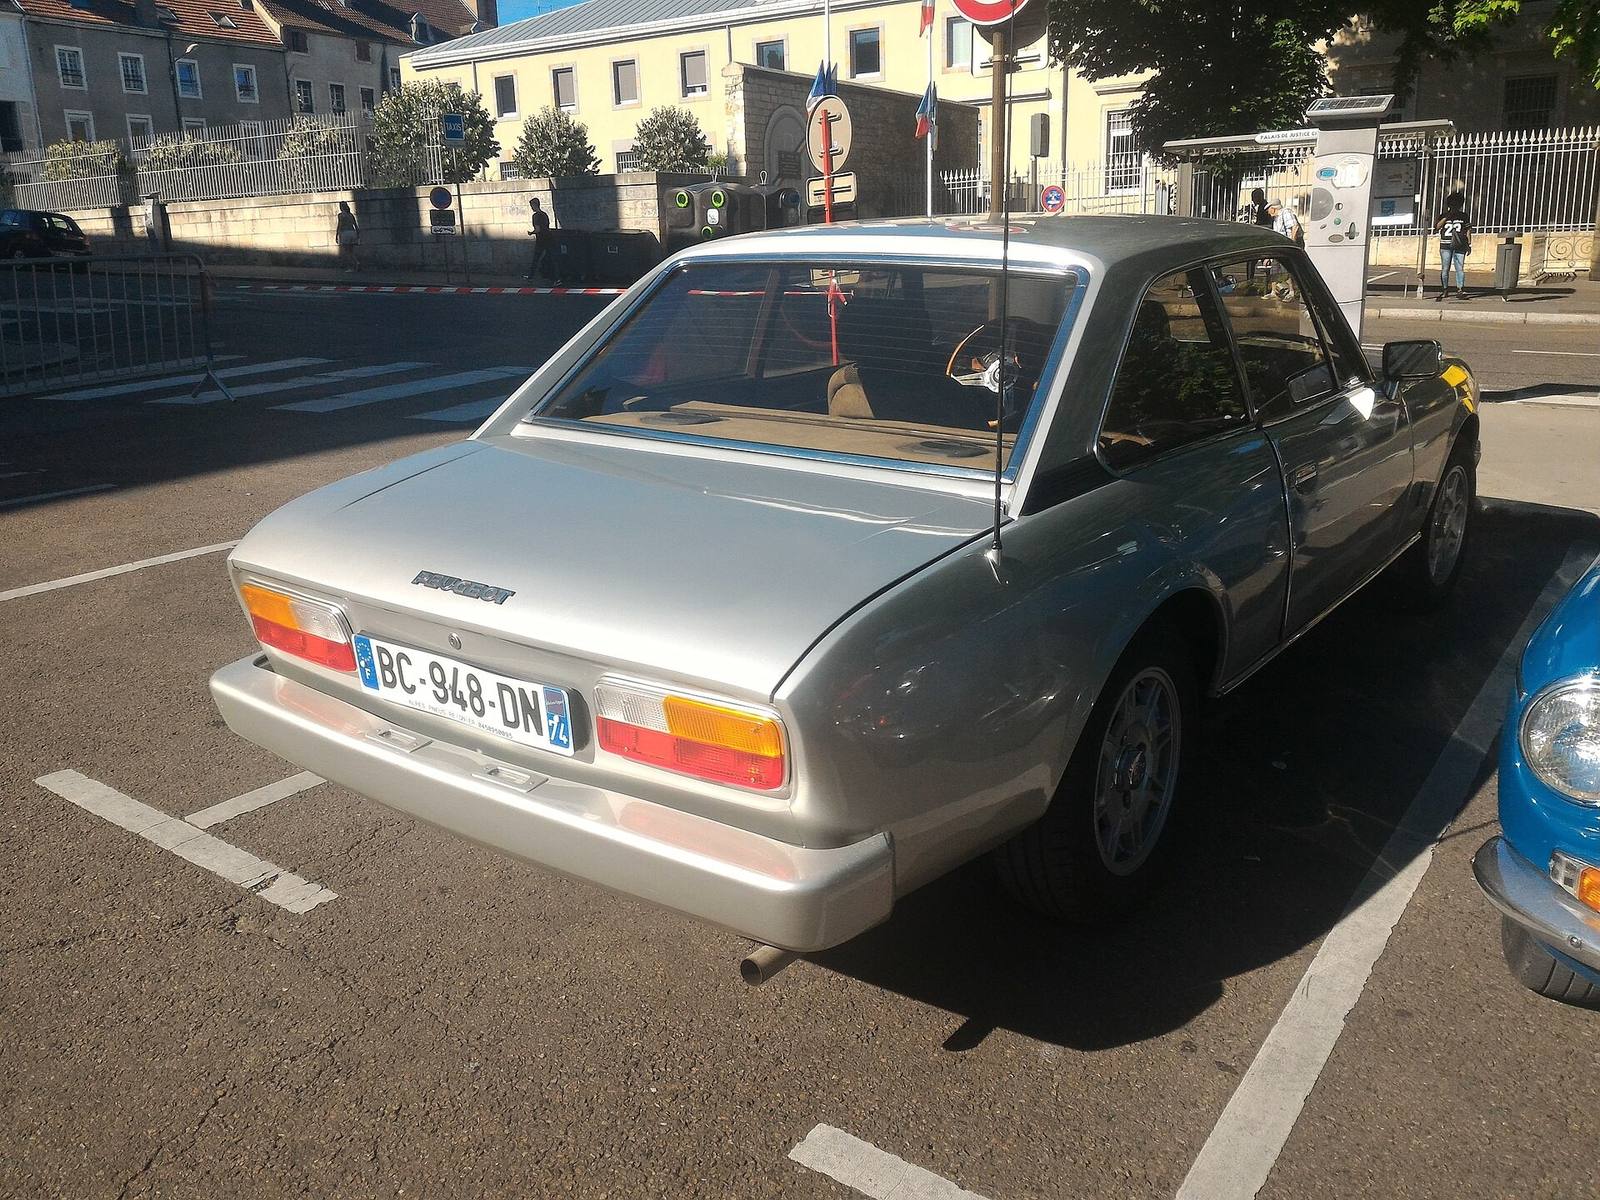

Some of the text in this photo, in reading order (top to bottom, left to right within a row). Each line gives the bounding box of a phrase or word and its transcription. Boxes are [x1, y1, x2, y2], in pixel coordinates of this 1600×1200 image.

[445, 122, 462, 132] TAXIS
[1289, 130, 1310, 138] JUSTICE
[411, 570, 516, 605] PEUGEOT
[364, 667, 371, 680] F
[376, 645, 543, 736] BC-948-DN
[548, 718, 569, 744] 74
